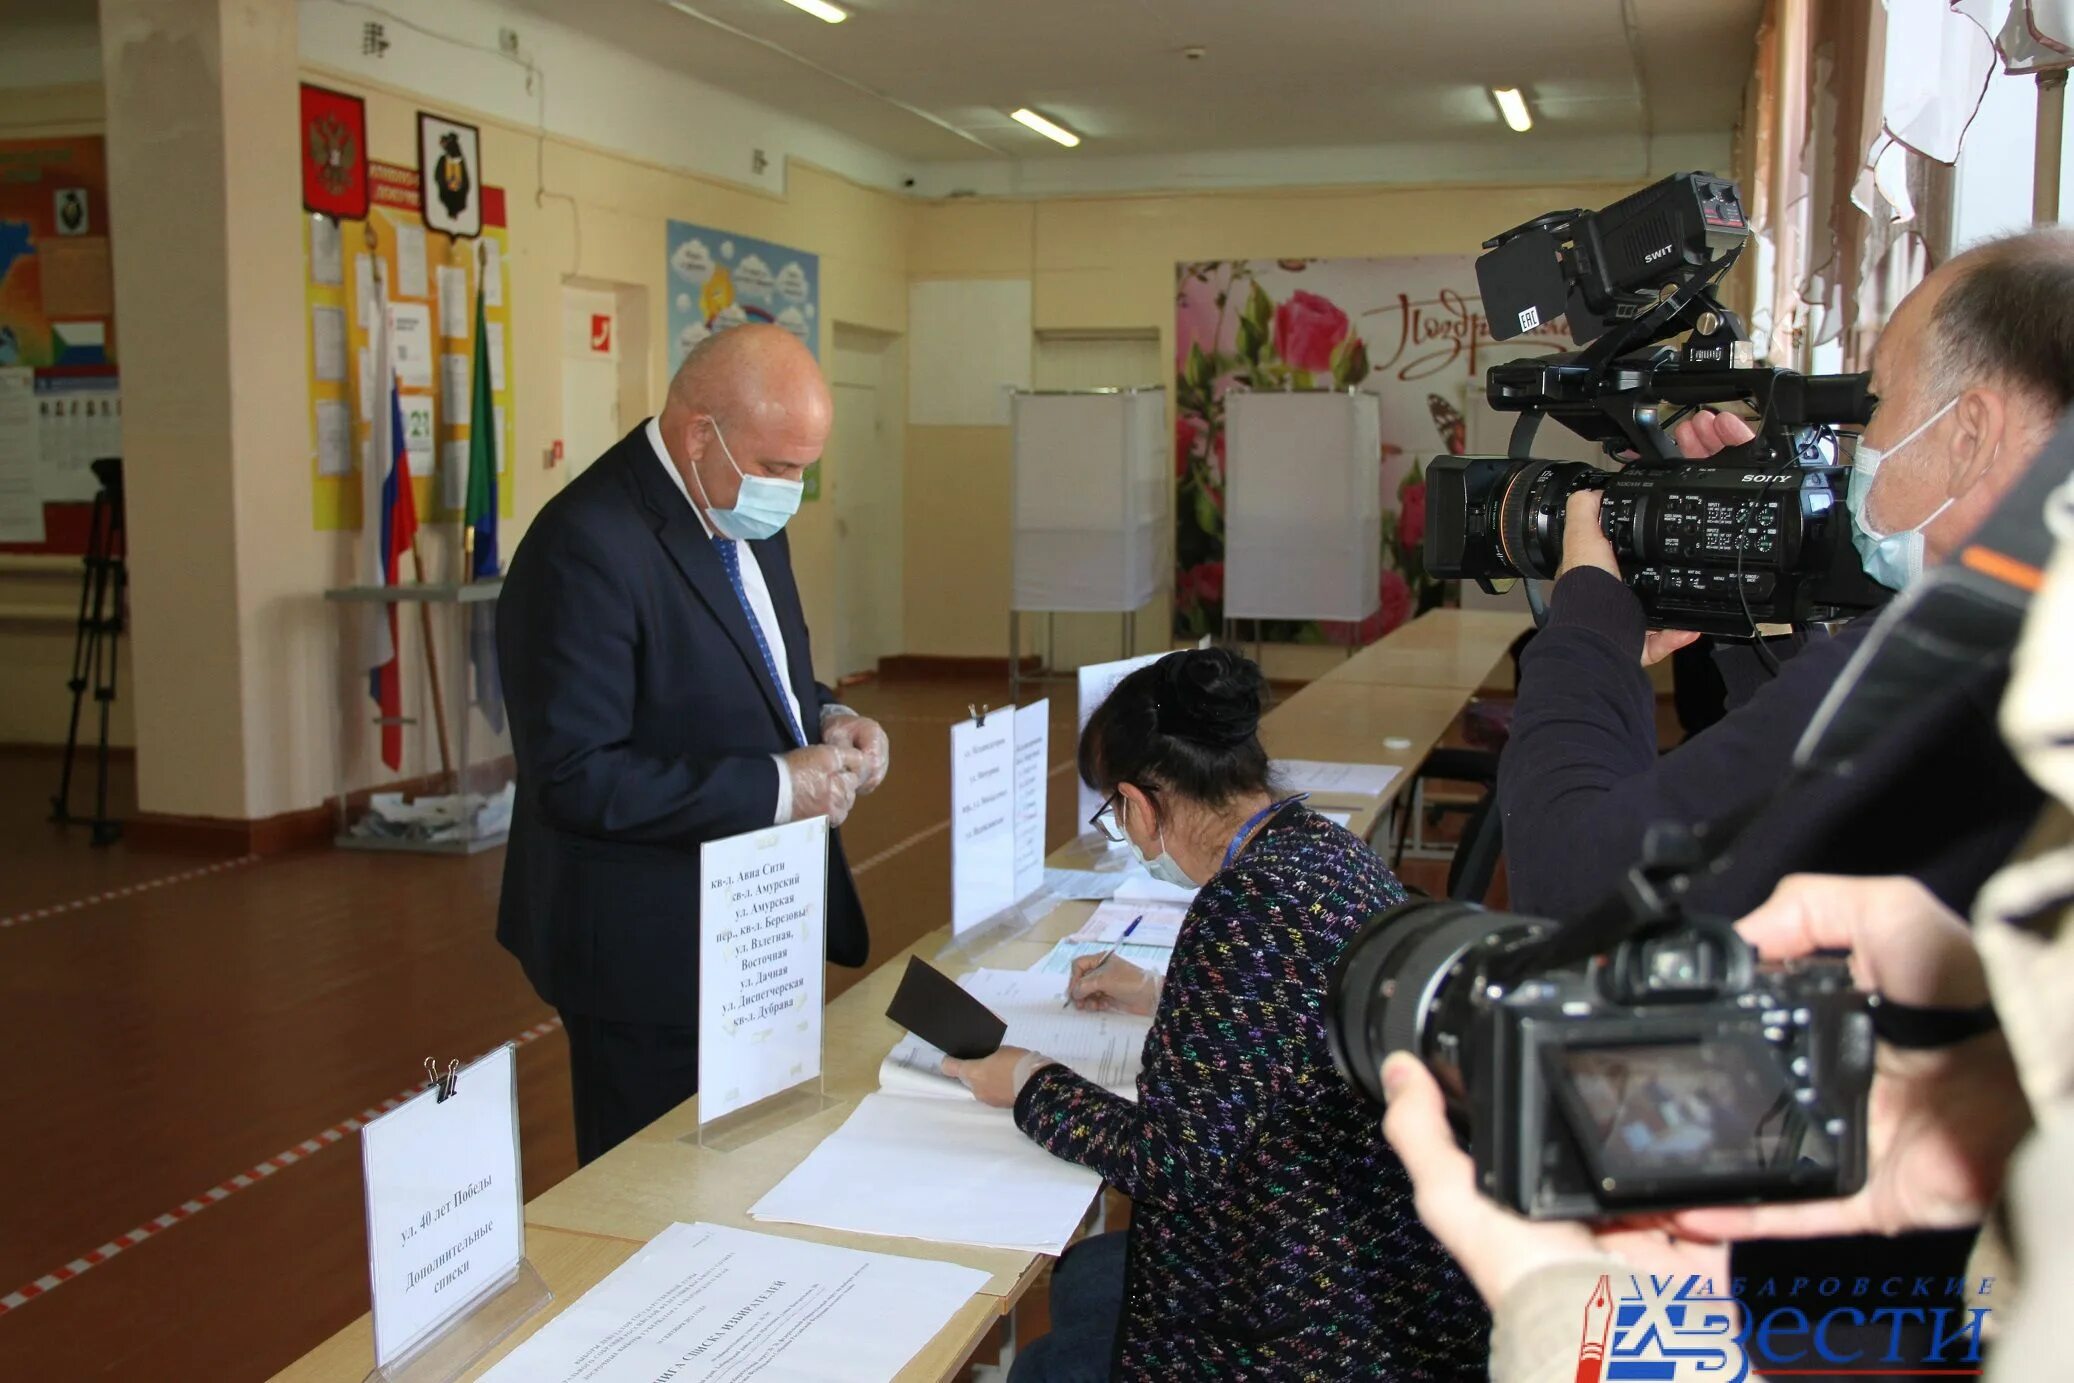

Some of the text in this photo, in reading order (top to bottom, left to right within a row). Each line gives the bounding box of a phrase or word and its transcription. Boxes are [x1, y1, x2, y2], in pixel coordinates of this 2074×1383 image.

[1644, 244, 1673, 264] SWIT
[738, 869, 760, 881] Авиа
[762, 862, 785, 875] Сити
[756, 872, 800, 896] Амурский
[735, 894, 795, 922] ул. Амурская
[735, 945, 749, 958] ул.
[741, 948, 788, 971] Восточная
[740, 966, 788, 992] ул. Дачная
[722, 977, 804, 1016] ул. Диспетчерская
[757, 998, 794, 1019] Дубрава
[400, 1173, 493, 1247] ул. 40 лет Победы
[405, 1218, 495, 1292] Дополнительные
[433, 1259, 470, 1294] списки
[682, 1331, 726, 1361] СПИСКА
[721, 1279, 786, 1331] ИЗБИРАТЕЛЕЙ
